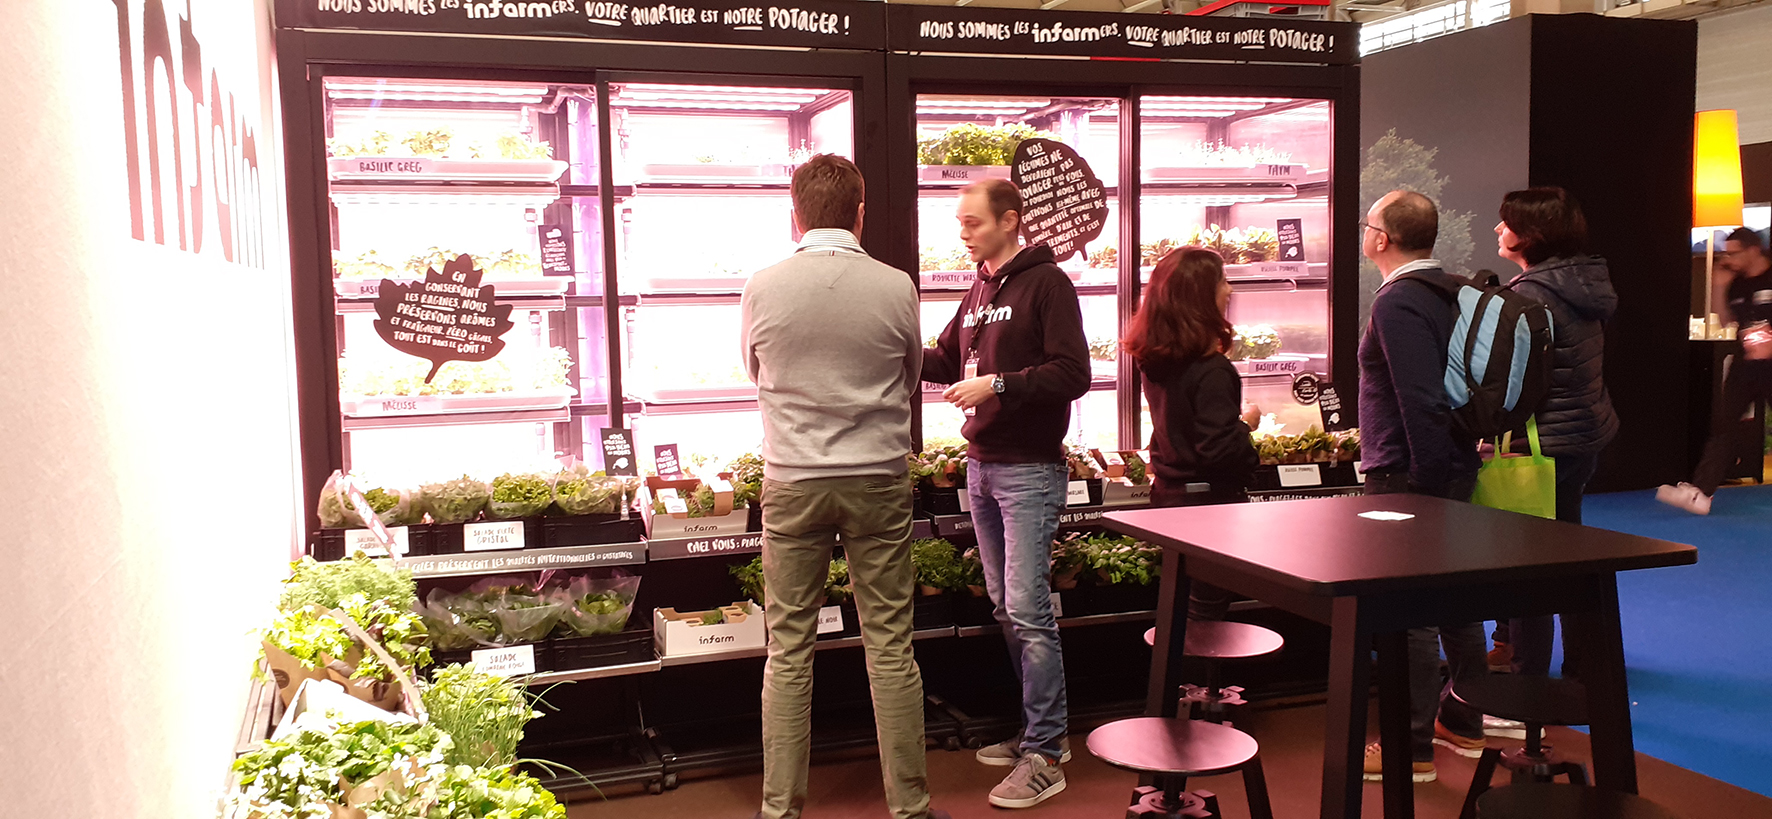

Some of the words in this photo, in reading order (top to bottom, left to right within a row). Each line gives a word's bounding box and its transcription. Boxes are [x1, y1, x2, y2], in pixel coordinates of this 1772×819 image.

[367, 0, 436, 15] SOMMES
[585, 1, 628, 22] VOTRE
[631, 4, 697, 26] QUARTIER
[700, 9, 718, 23] EST
[723, 7, 763, 26] NOTRE
[768, 6, 839, 35] POTAGER
[920, 20, 954, 39] NOUS
[957, 21, 1011, 41] SOMMES
[1013, 20, 1030, 35] LES
[1125, 24, 1160, 43] VOTRE
[1161, 26, 1214, 47] QUARTIER
[1215, 31, 1230, 44] EST
[1233, 29, 1266, 45] NOTRE
[1269, 28, 1325, 52] POTAGER
[1026, 142, 1043, 156] VOS
[1018, 154, 1050, 175] LÉGUMES
[1050, 149, 1063, 164] NE
[1060, 158, 1074, 172] PAS
[1056, 185, 1075, 198] NOUS
[1076, 180, 1088, 191] LES
[1081, 187, 1100, 200] AVEC
[1094, 199, 1105, 210] DE
[452, 271, 467, 283] EN
[963, 274, 977, 282] WAS
[405, 292, 419, 302] LES
[462, 298, 488, 313] NOUS
[390, 316, 401, 325] ET
[393, 331, 415, 342] TOUT
[416, 333, 432, 345] EST
[683, 524, 718, 533] infarm
[686, 540, 710, 554] CHEZ
[492, 557, 505, 569] LES
[698, 634, 735, 646] infarm
